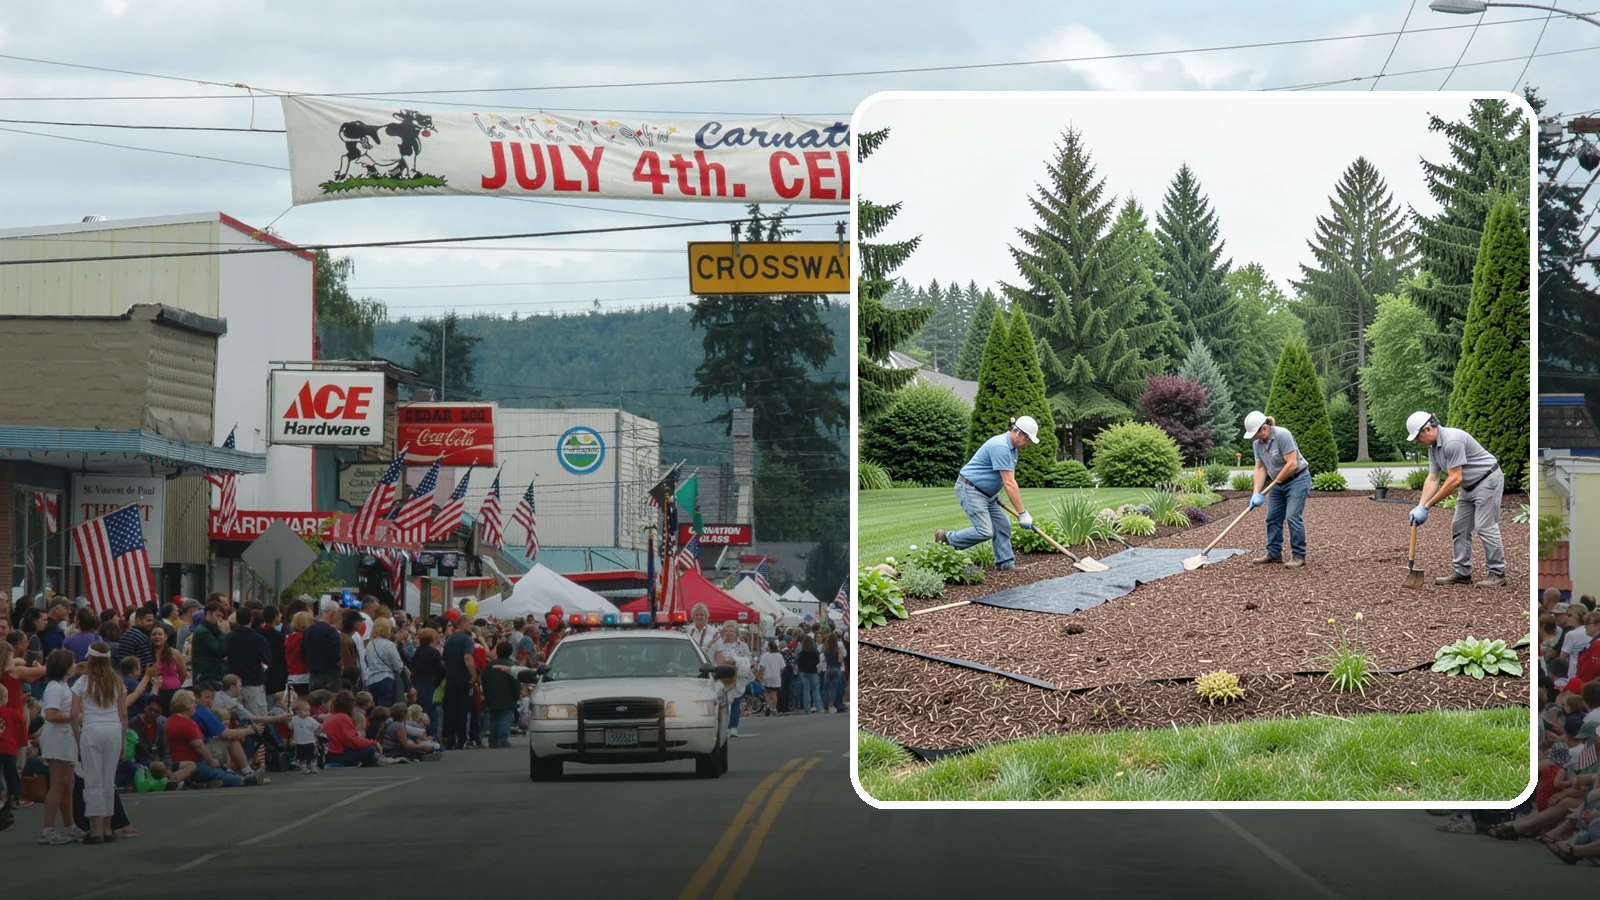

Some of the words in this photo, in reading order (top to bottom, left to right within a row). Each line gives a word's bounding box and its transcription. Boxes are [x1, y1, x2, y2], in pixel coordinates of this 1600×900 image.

[695, 121, 850, 149] Carnat
[481, 141, 605, 192] JULY
[632, 150, 747, 198] 4th.
[697, 254, 850, 280] CROSSWA
[283, 380, 374, 420] ACE
[405, 409, 452, 422] CEDAR
[284, 421, 370, 436] Hardware
[416, 428, 477, 447] Coca-Cola
[83, 484, 94, 495] St.
[96, 485, 124, 495] Vincent
[126, 486, 136, 495] de
[138, 486, 155, 495] Paul
[688, 526, 741, 535] CRNATION
[699, 535, 730, 543] GLASS
